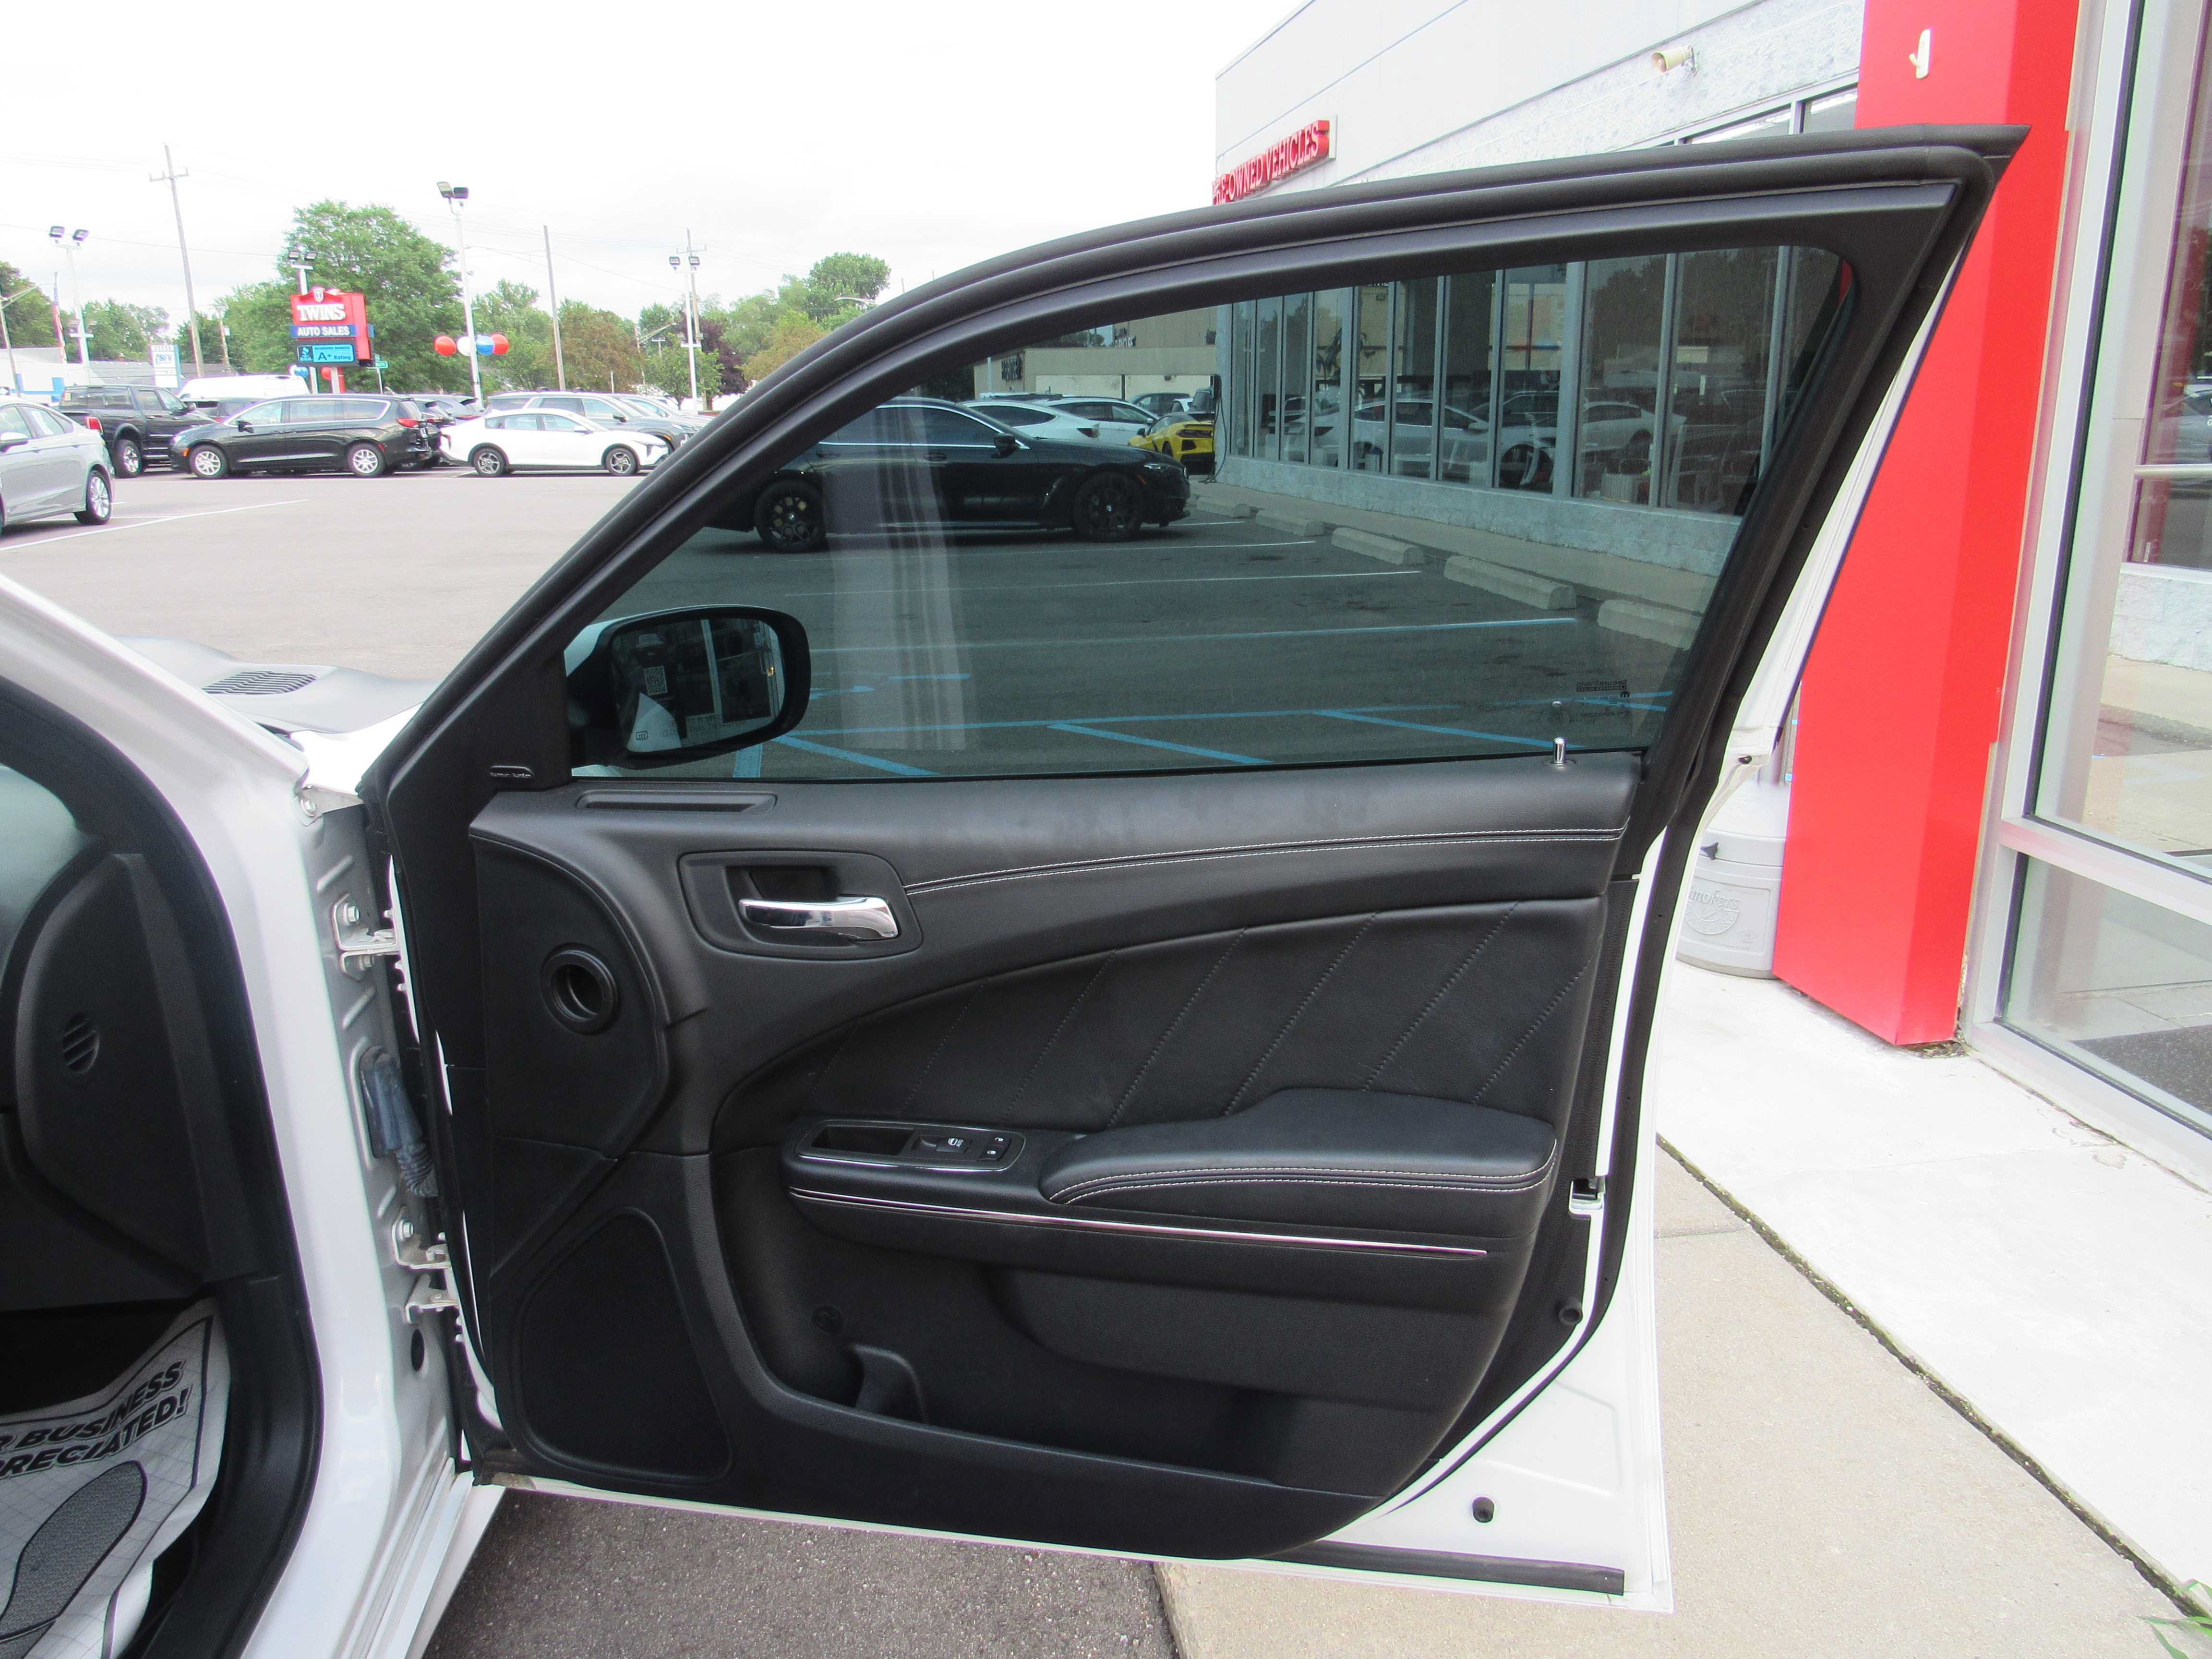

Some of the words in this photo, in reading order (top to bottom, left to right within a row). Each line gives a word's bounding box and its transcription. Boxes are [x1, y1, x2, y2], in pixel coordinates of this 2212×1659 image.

[1212, 154, 1264, 205] PRE-OWNED
[1265, 120, 1326, 180] VEHICLES
[297, 303, 346, 321] TWINS
[298, 326, 320, 336] AUTO
[321, 325, 350, 336] SALES
[317, 352, 332, 361] A+
[1688, 889, 1740, 910] mokers
[14, 1359, 187, 1450] BUSINESS
[0, 1384, 193, 1479] RECIATED!
